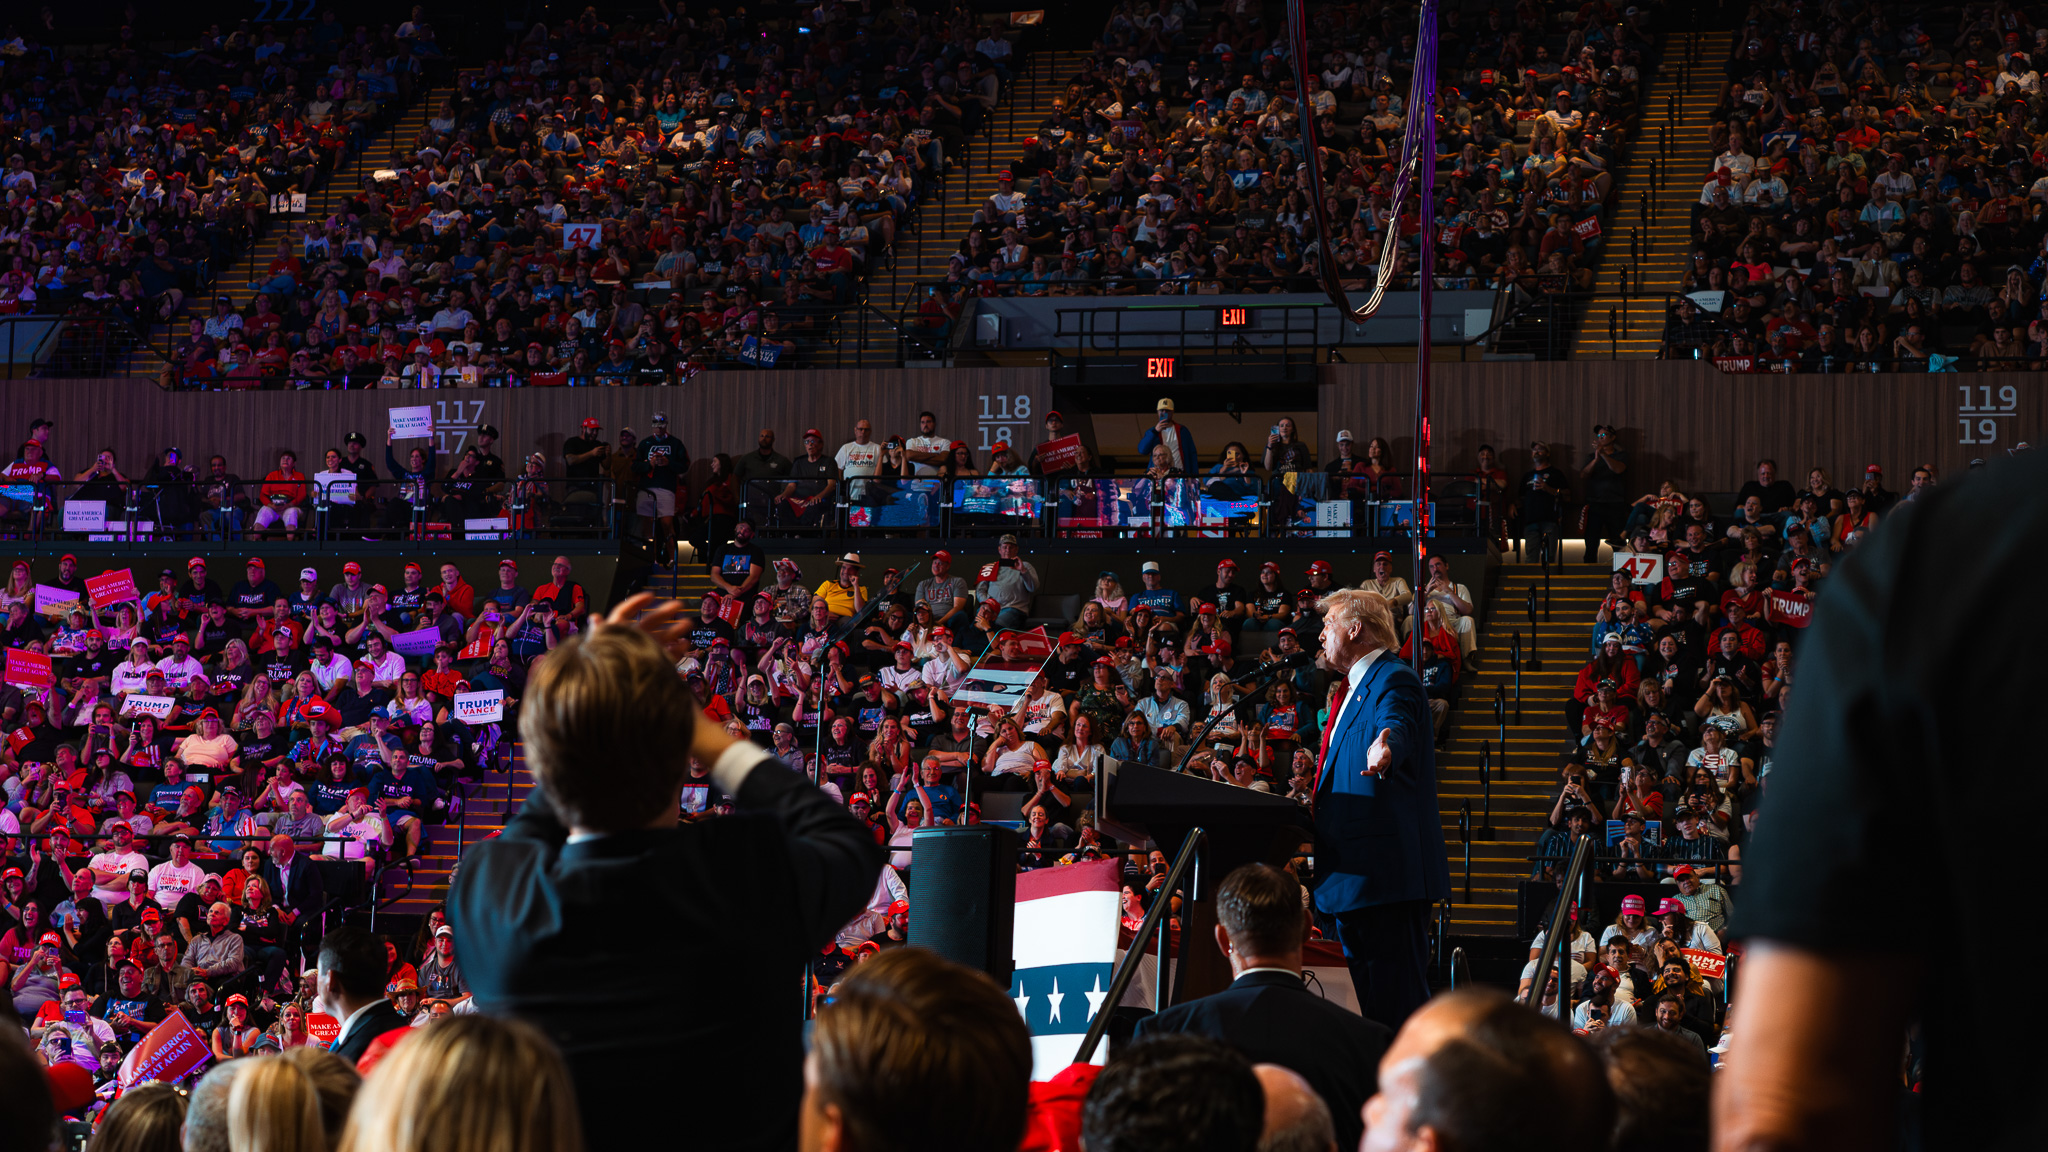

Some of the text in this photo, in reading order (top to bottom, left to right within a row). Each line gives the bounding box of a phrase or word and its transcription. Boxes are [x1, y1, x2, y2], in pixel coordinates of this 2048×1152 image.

[253, 0, 317, 22] 222
[1122, 126, 1142, 134] UMP
[1233, 173, 1259, 190] 47
[568, 228, 597, 248] 47
[1147, 358, 1175, 378] EXIT
[1715, 359, 1750, 373] TRUMP
[1958, 385, 2016, 411] 119
[436, 400, 485, 424] 117
[978, 395, 1031, 419] 118
[978, 426, 1012, 450] 18
[1958, 419, 1996, 444] 19
[436, 431, 468, 455] 17
[12, 466, 42, 476] TRUMP
[1621, 558, 1657, 579] 47
[90, 579, 131, 594] MAKE AMERICA
[94, 585, 130, 599] GREAT AGAIN
[240, 594, 264, 603] TRUMP
[928, 588, 951, 600] USA
[1139, 598, 1172, 607] TRUMP
[1771, 596, 1810, 617] TRUMP
[10, 659, 50, 670] MAKE AMERICA
[12, 665, 48, 676] GREAT AGAIN
[128, 700, 170, 709] TRUMP
[458, 698, 500, 710] TRUMP
[462, 706, 496, 715] VANCE
[408, 754, 438, 766] TRUMP
[318, 785, 350, 796] TRUMP
[853, 792, 868, 800] MAGA
[159, 885, 188, 894] TRUMP
[42, 932, 59, 942] MAGA
[13, 946, 32, 958] TRU
[1684, 953, 1725, 967] RUMP
[126, 1028, 190, 1085] MAKE AMERICA
[134, 1039, 193, 1088] GREAT AGAIN
